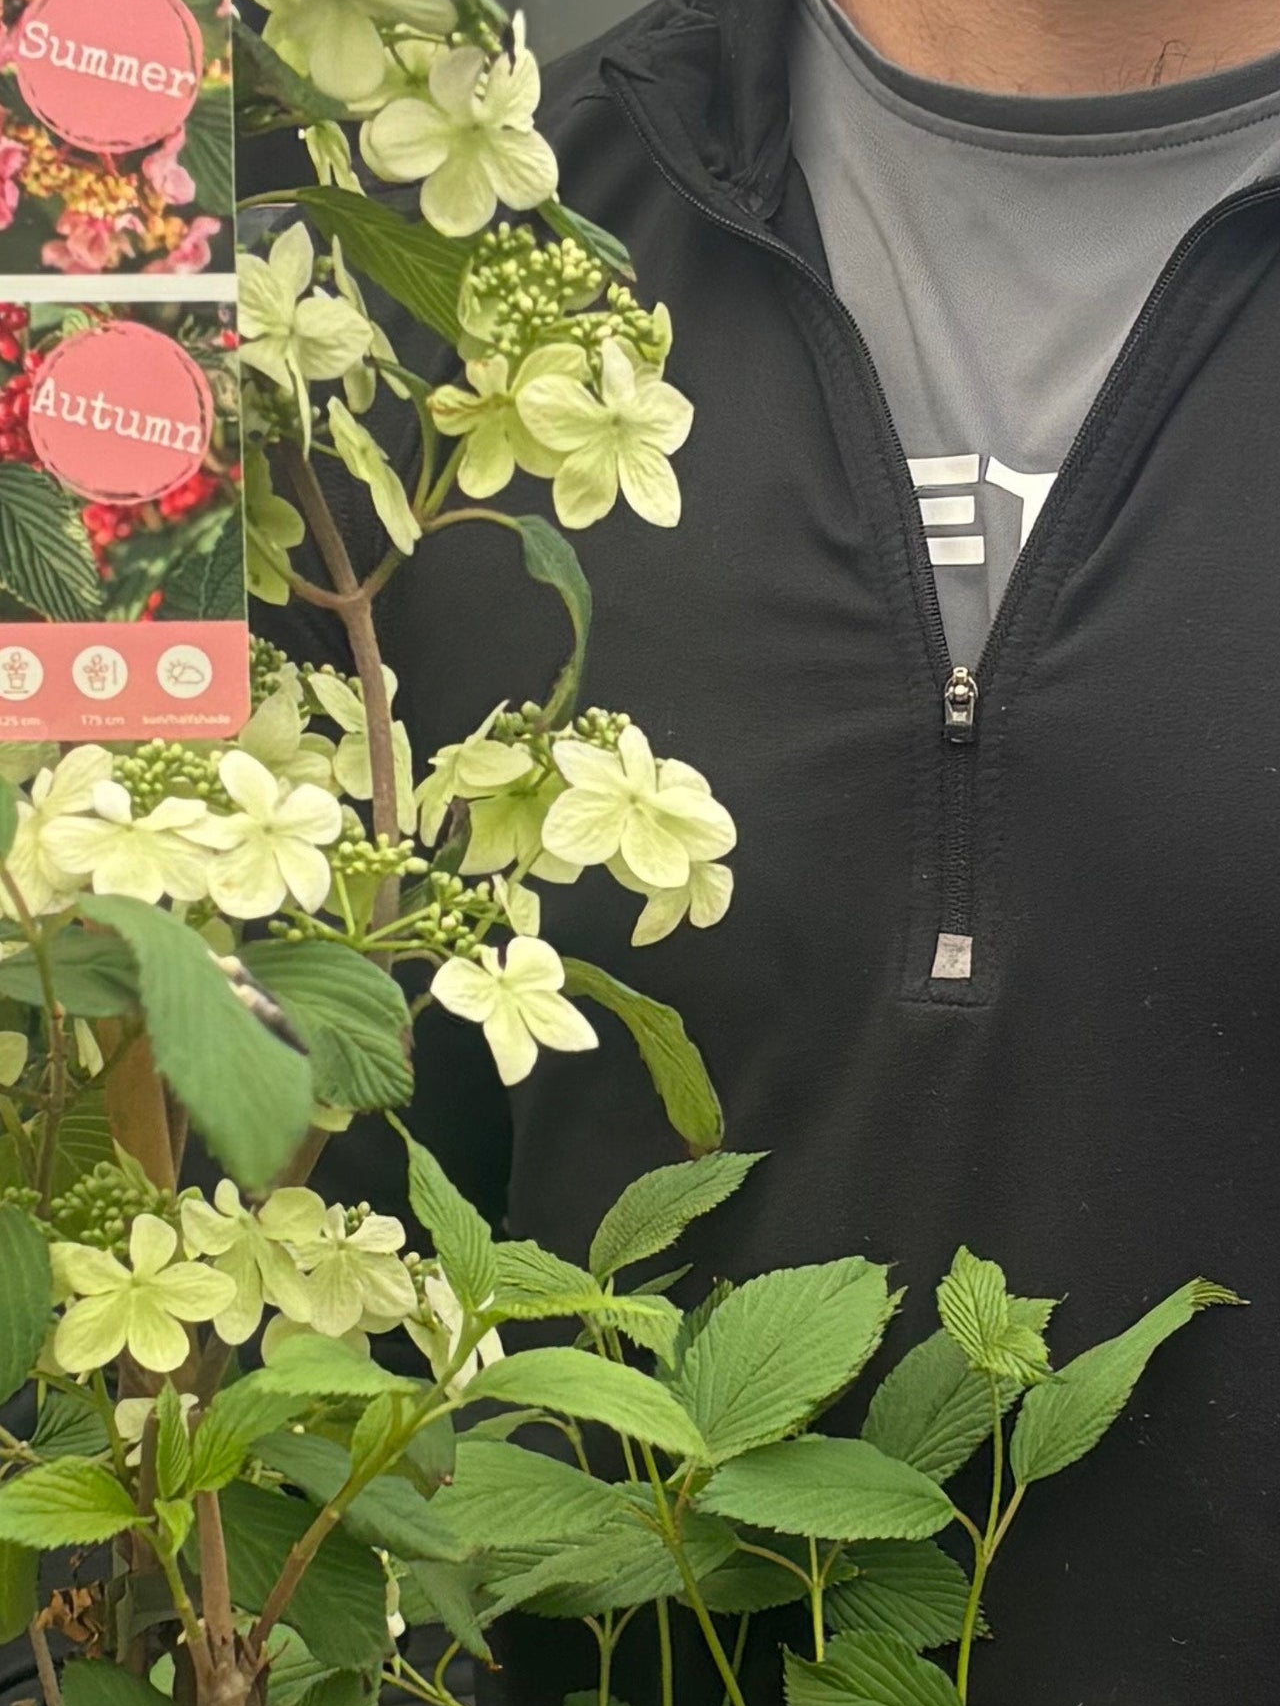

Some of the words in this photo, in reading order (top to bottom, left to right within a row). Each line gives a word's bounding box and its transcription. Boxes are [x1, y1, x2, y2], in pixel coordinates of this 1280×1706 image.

[18, 20, 197, 98] Summer
[31, 376, 203, 455] Autumn
[105, 716, 125, 726] cm
